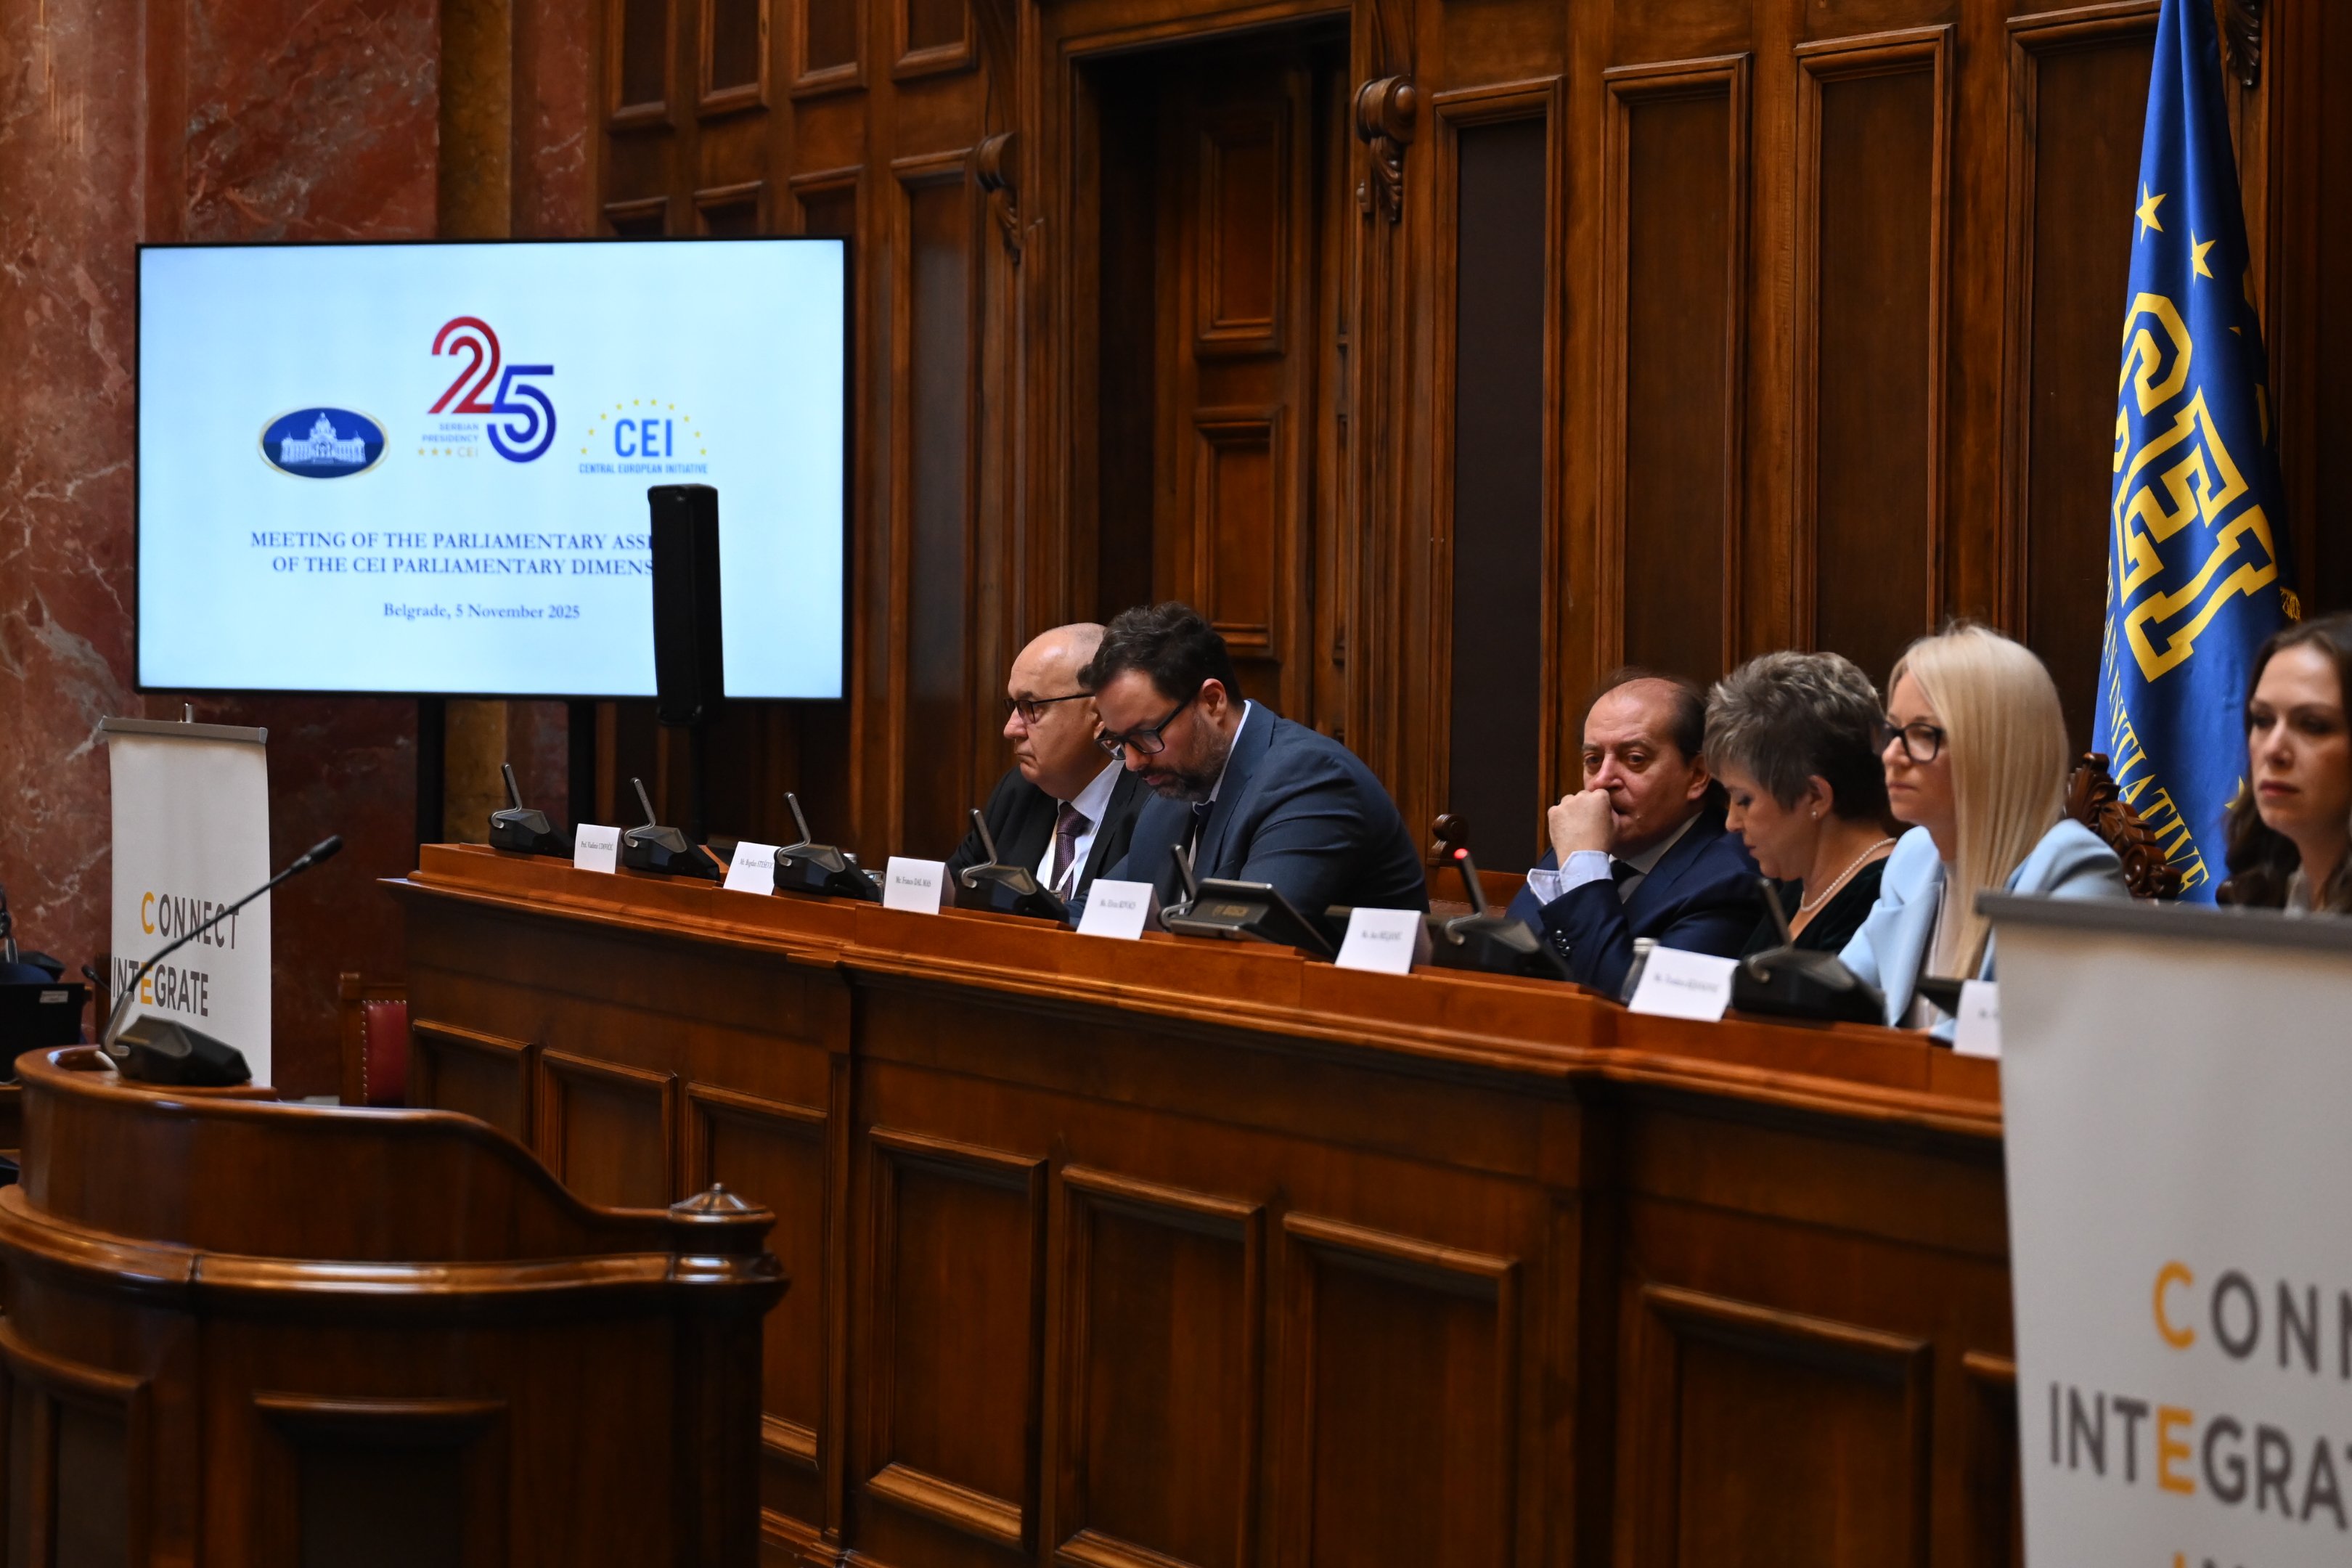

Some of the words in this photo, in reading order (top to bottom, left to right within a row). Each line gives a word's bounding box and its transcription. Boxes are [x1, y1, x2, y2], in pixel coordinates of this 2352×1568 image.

[427, 316, 557, 463] 25
[439, 422, 479, 431] SERBIAN
[615, 419, 672, 457] CEI
[457, 446, 478, 457] CEI
[579, 463, 616, 474] CENTRAL
[618, 463, 662, 474] EUROPEAN
[666, 463, 709, 474] INITIATIVE
[251, 531, 346, 548] MEETING
[351, 532, 379, 548] OF
[383, 532, 427, 549] THE
[433, 532, 607, 550] PARLIAMENTARY
[272, 556, 300, 573] OF
[304, 556, 347, 573] THE
[353, 556, 386, 573] CEI
[393, 558, 566, 574] PARLIAMENTARY
[571, 558, 653, 575] DIMENS
[383, 602, 452, 621] Belgrade,
[456, 604, 463, 618] 5
[467, 603, 544, 618] November
[548, 604, 580, 618] 2025
[142, 891, 240, 950] CONNECT
[113, 957, 208, 1017] INTEGRATE
[2049, 1381, 2352, 1530] INTEGRA
